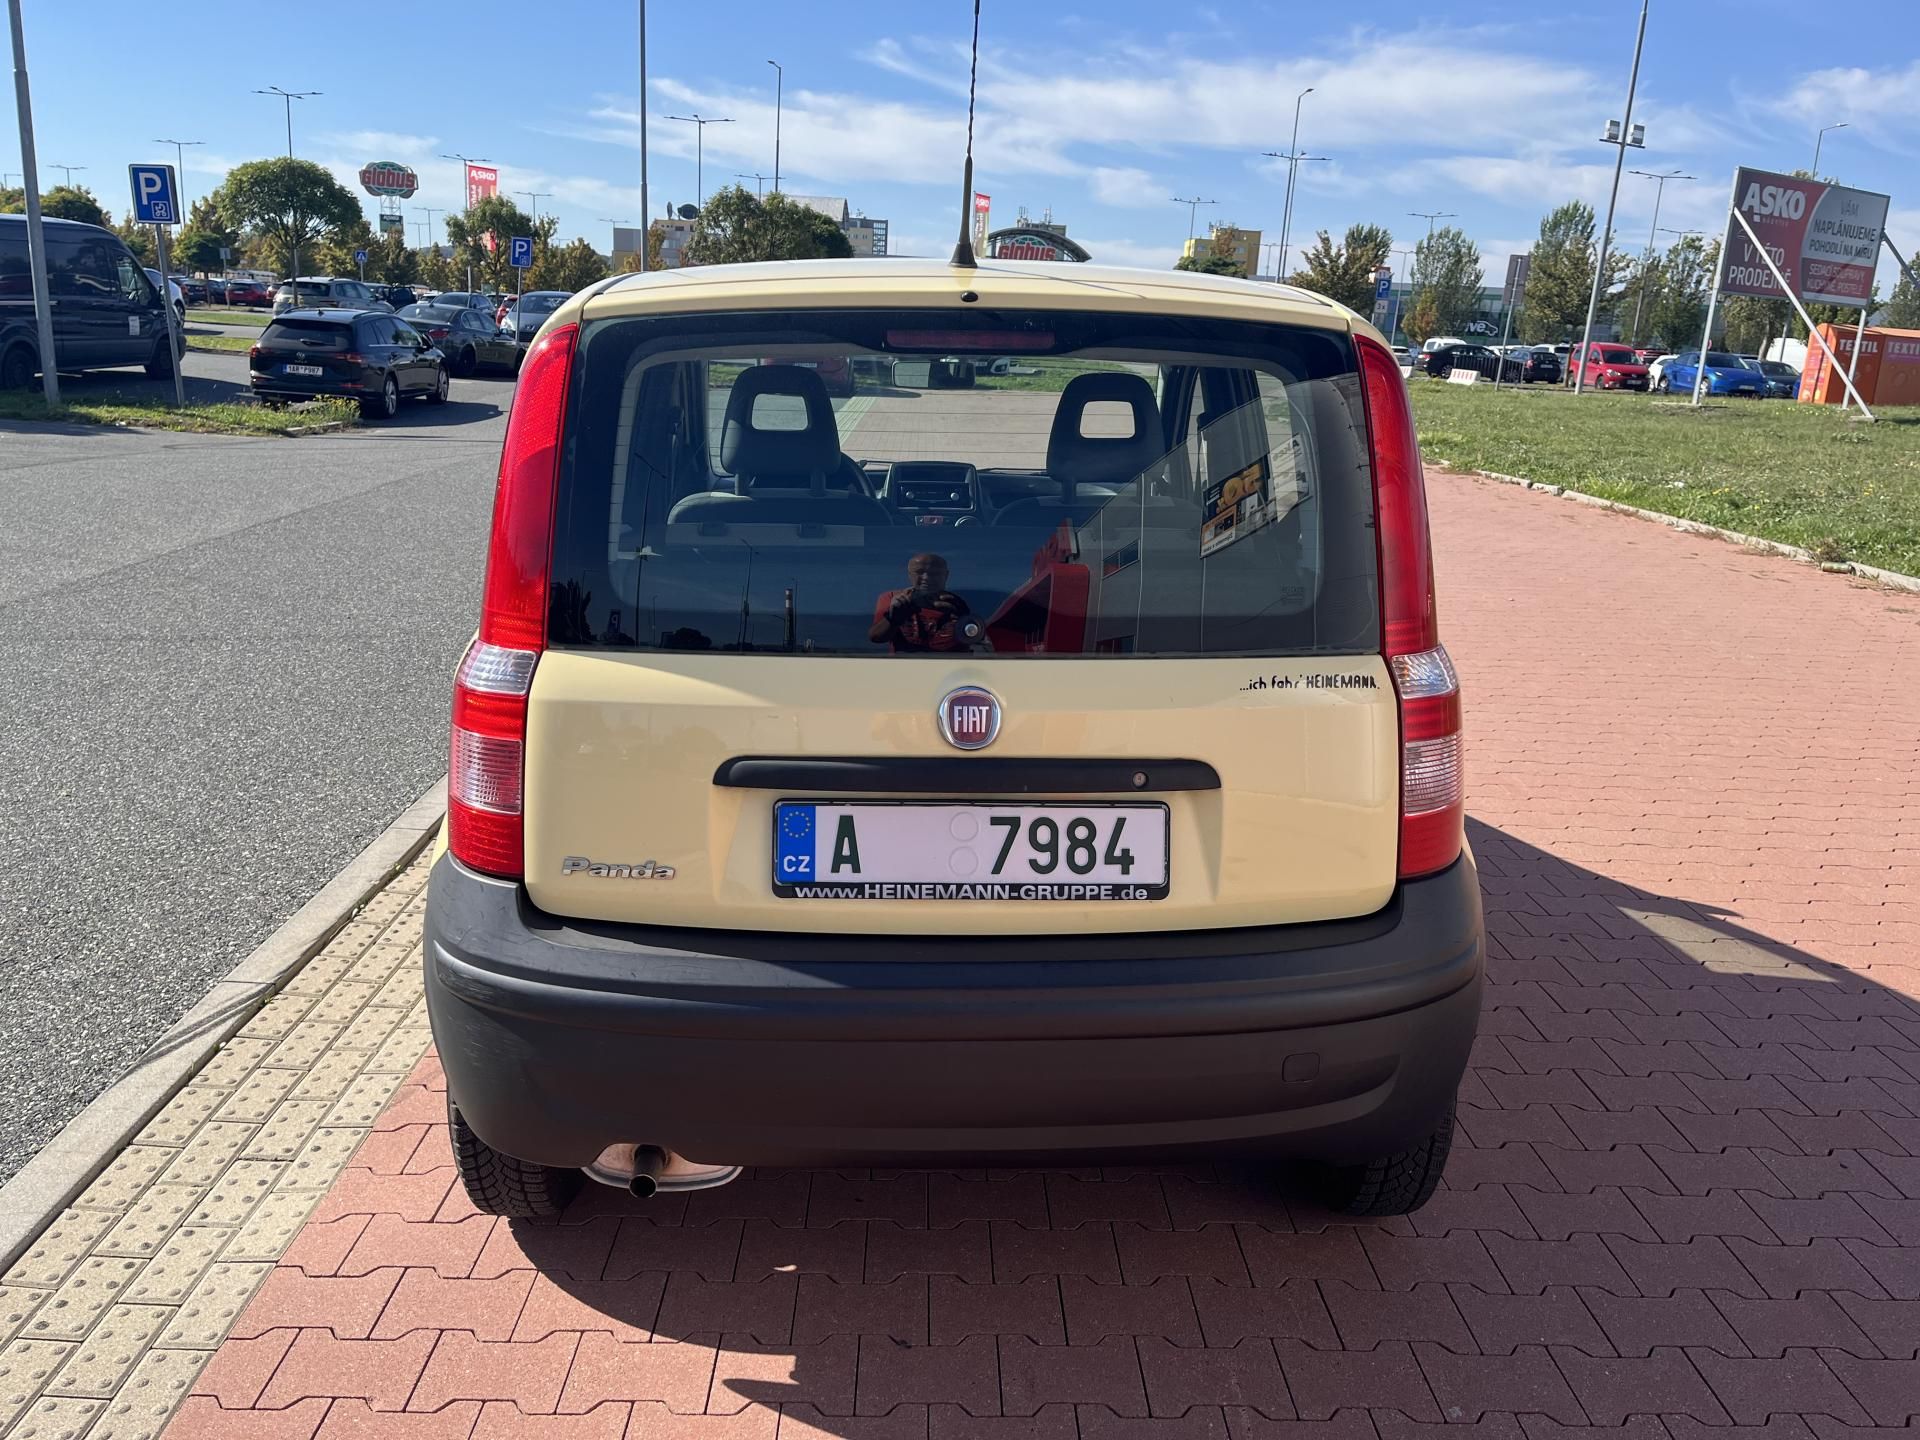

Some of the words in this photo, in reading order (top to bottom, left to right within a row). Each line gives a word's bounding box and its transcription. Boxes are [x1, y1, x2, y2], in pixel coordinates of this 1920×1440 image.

[470, 169, 496, 181] ASKO
[138, 172, 162, 206] P
[1742, 183, 1806, 220] ASKO
[1813, 219, 1877, 241] NAPLÁNUJEME
[515, 241, 528, 258] P
[1744, 243, 1753, 262] V
[1809, 240, 1842, 254] POHODLÍ
[1843, 245, 1854, 256] NA
[1380, 281, 1389, 293] P
[1839, 339, 1878, 353] TETIL
[953, 705, 990, 733] FIAT
[783, 855, 810, 872] CZ
[830, 815, 861, 873] A
[990, 816, 1135, 875] 7984
[562, 856, 676, 880] Panda
[795, 883, 1148, 900] www.HEINEMANN-GRUPPE.de
